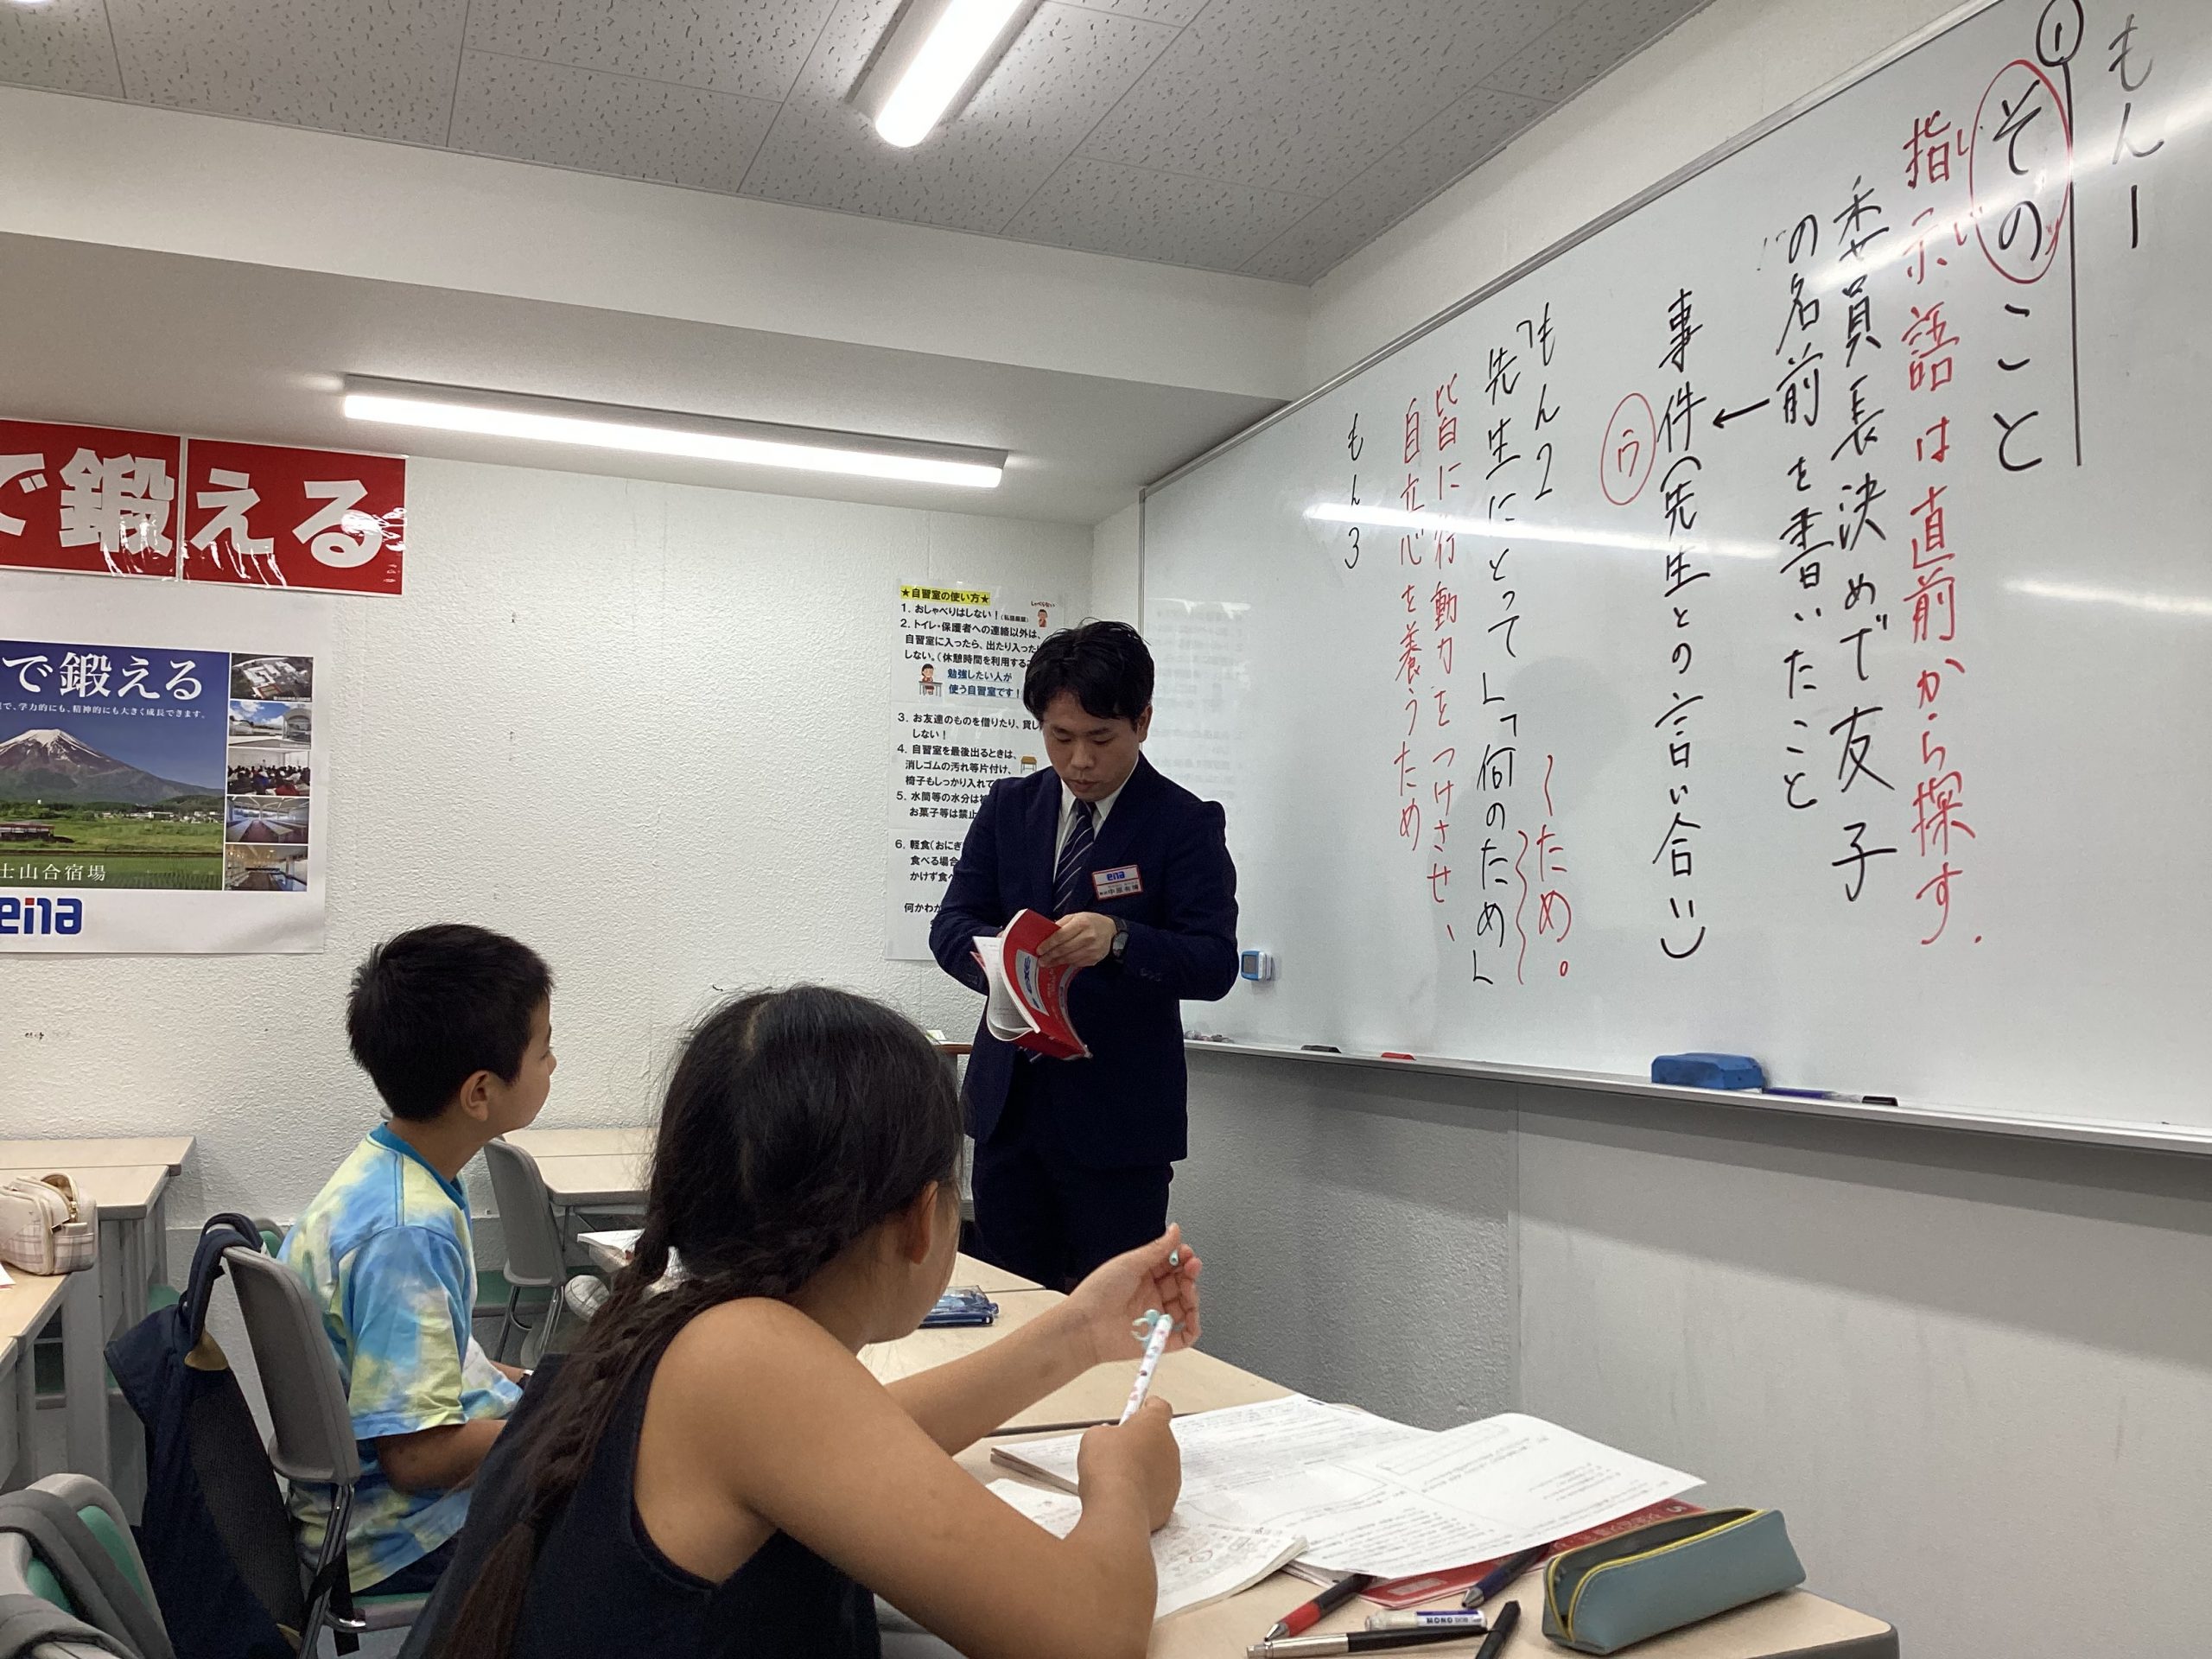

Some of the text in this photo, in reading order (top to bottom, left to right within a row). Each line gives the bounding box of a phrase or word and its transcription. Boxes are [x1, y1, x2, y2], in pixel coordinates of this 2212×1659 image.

[1992, 79, 2043, 473] そのこと
[1535, 302, 1560, 500] もん2
[1344, 413, 1363, 569] もん3
[1775, 214, 1834, 810] の名前を書いたこと
[2, 651, 202, 701] で鍛える
[948, 668, 1012, 682] 勉強したい人が
[912, 728, 946, 740] しない！
[906, 760, 1012, 775] 消しゴムの汚れ等片付け、
[1107, 871, 1125, 880] ena
